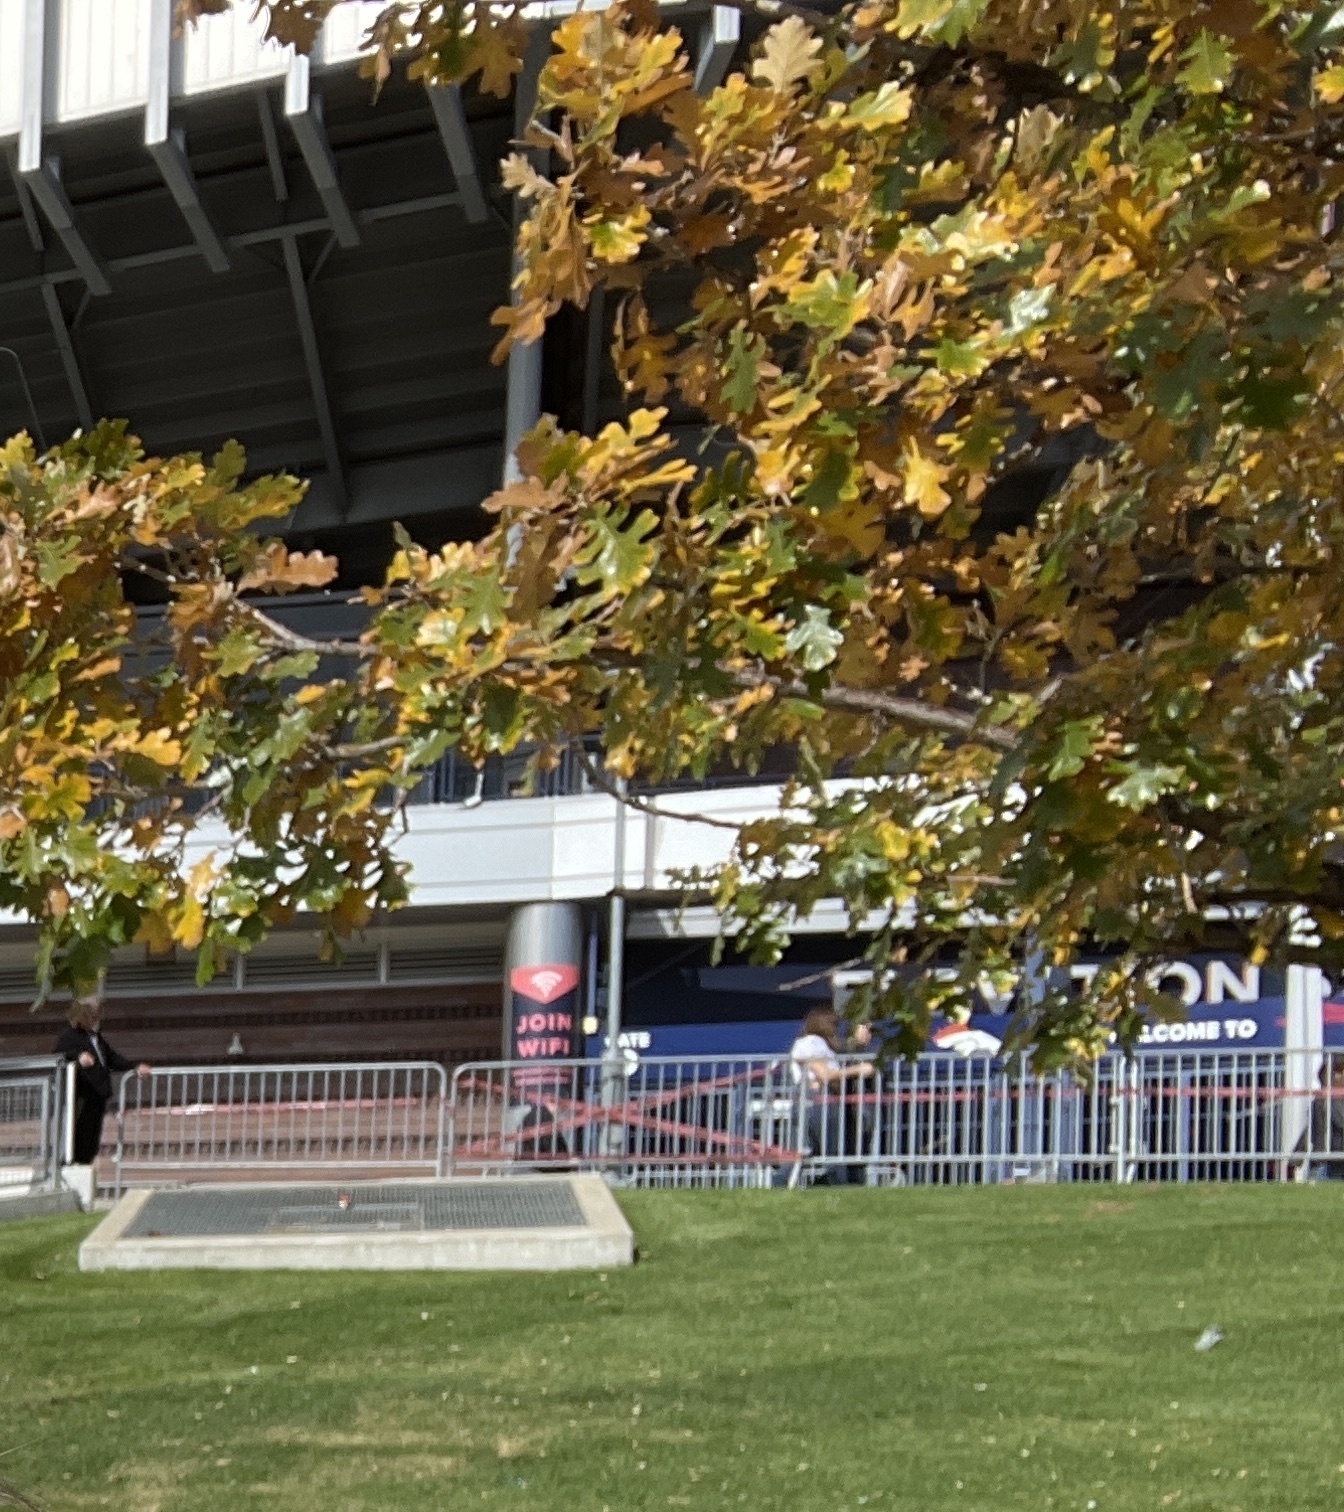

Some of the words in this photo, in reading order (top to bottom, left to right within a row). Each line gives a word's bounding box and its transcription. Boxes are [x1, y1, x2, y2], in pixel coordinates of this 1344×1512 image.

[517, 1012, 572, 1034] JOIN
[1223, 1018, 1258, 1039] TO
[517, 1036, 570, 1058] WIFI
